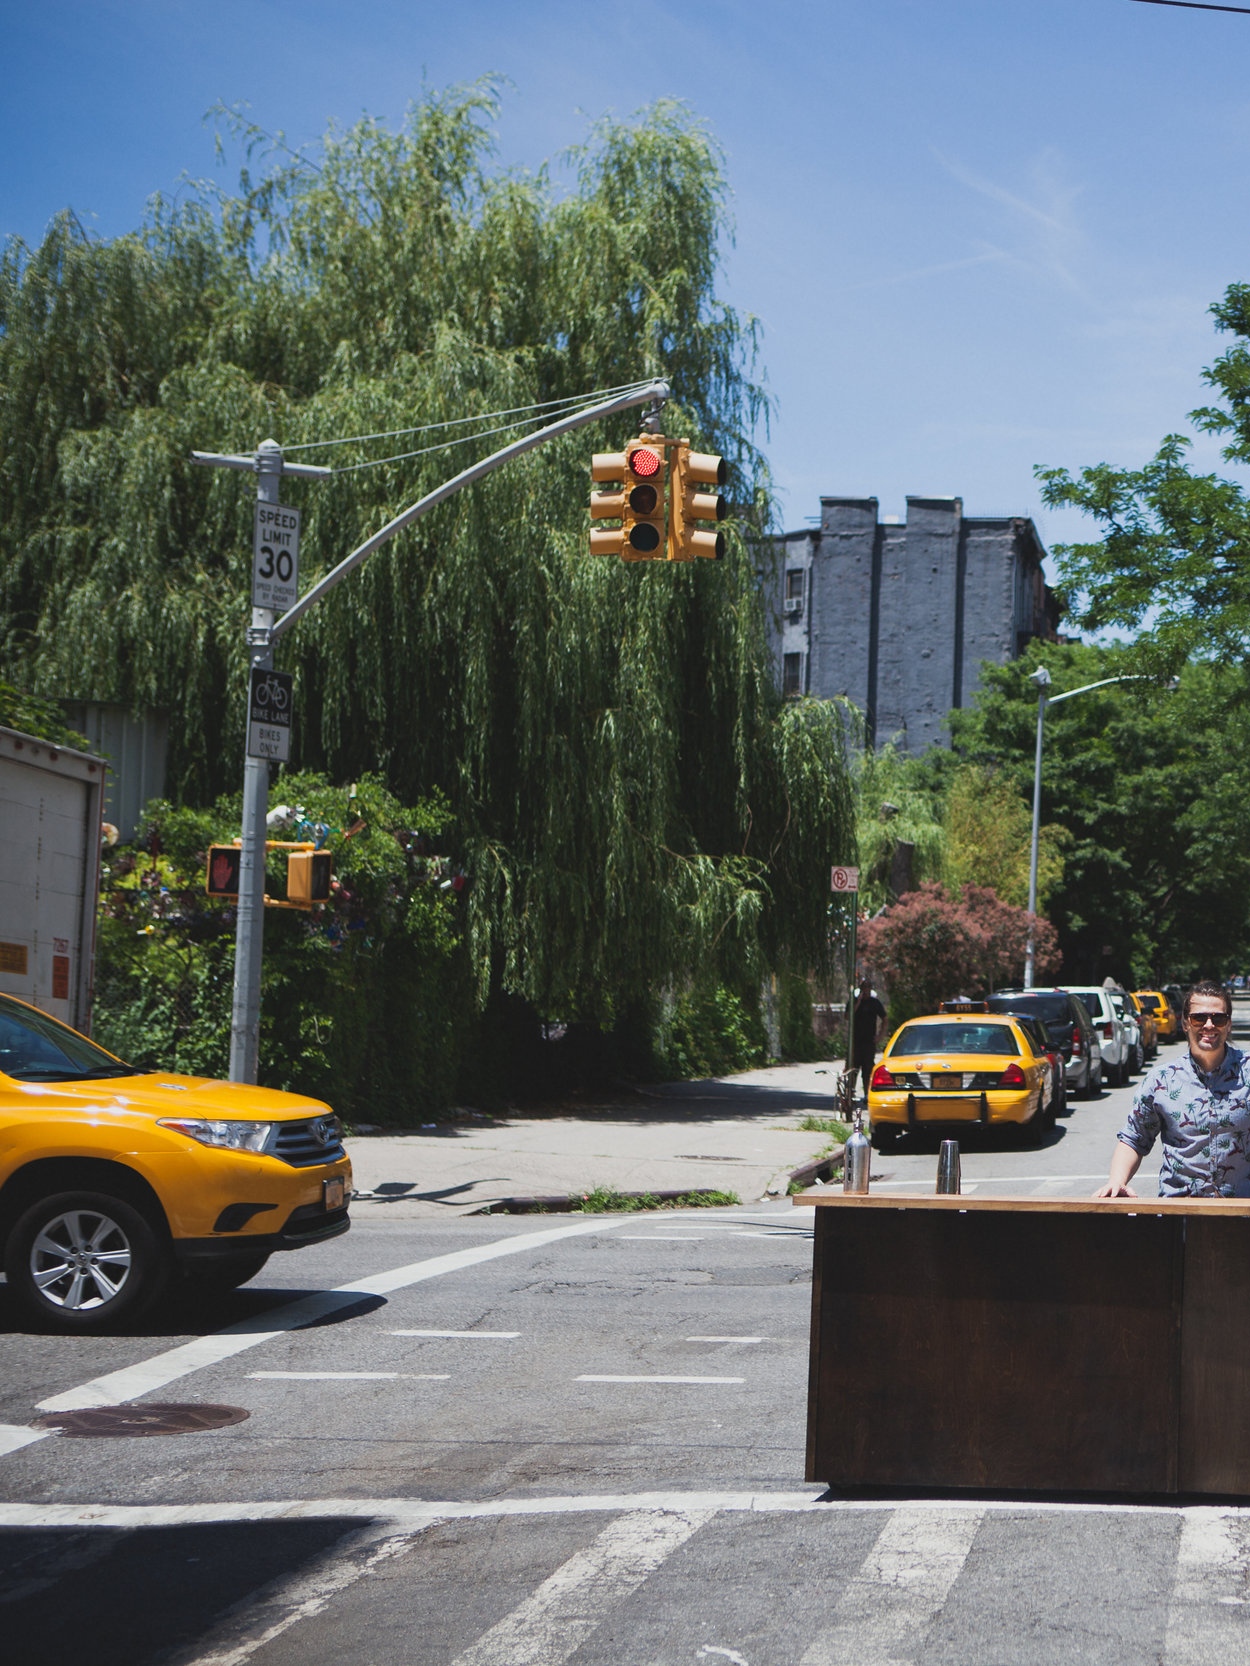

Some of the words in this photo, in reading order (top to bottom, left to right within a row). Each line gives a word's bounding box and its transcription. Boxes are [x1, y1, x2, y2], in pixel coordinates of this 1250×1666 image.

[259, 510, 297, 529] SPEED
[262, 528, 292, 546] LIMIT
[259, 546, 293, 582] 30
[252, 707, 268, 720] BIKE
[271, 711, 289, 724] LANE
[259, 727, 281, 742] BIKES
[259, 742, 280, 755] ONLY
